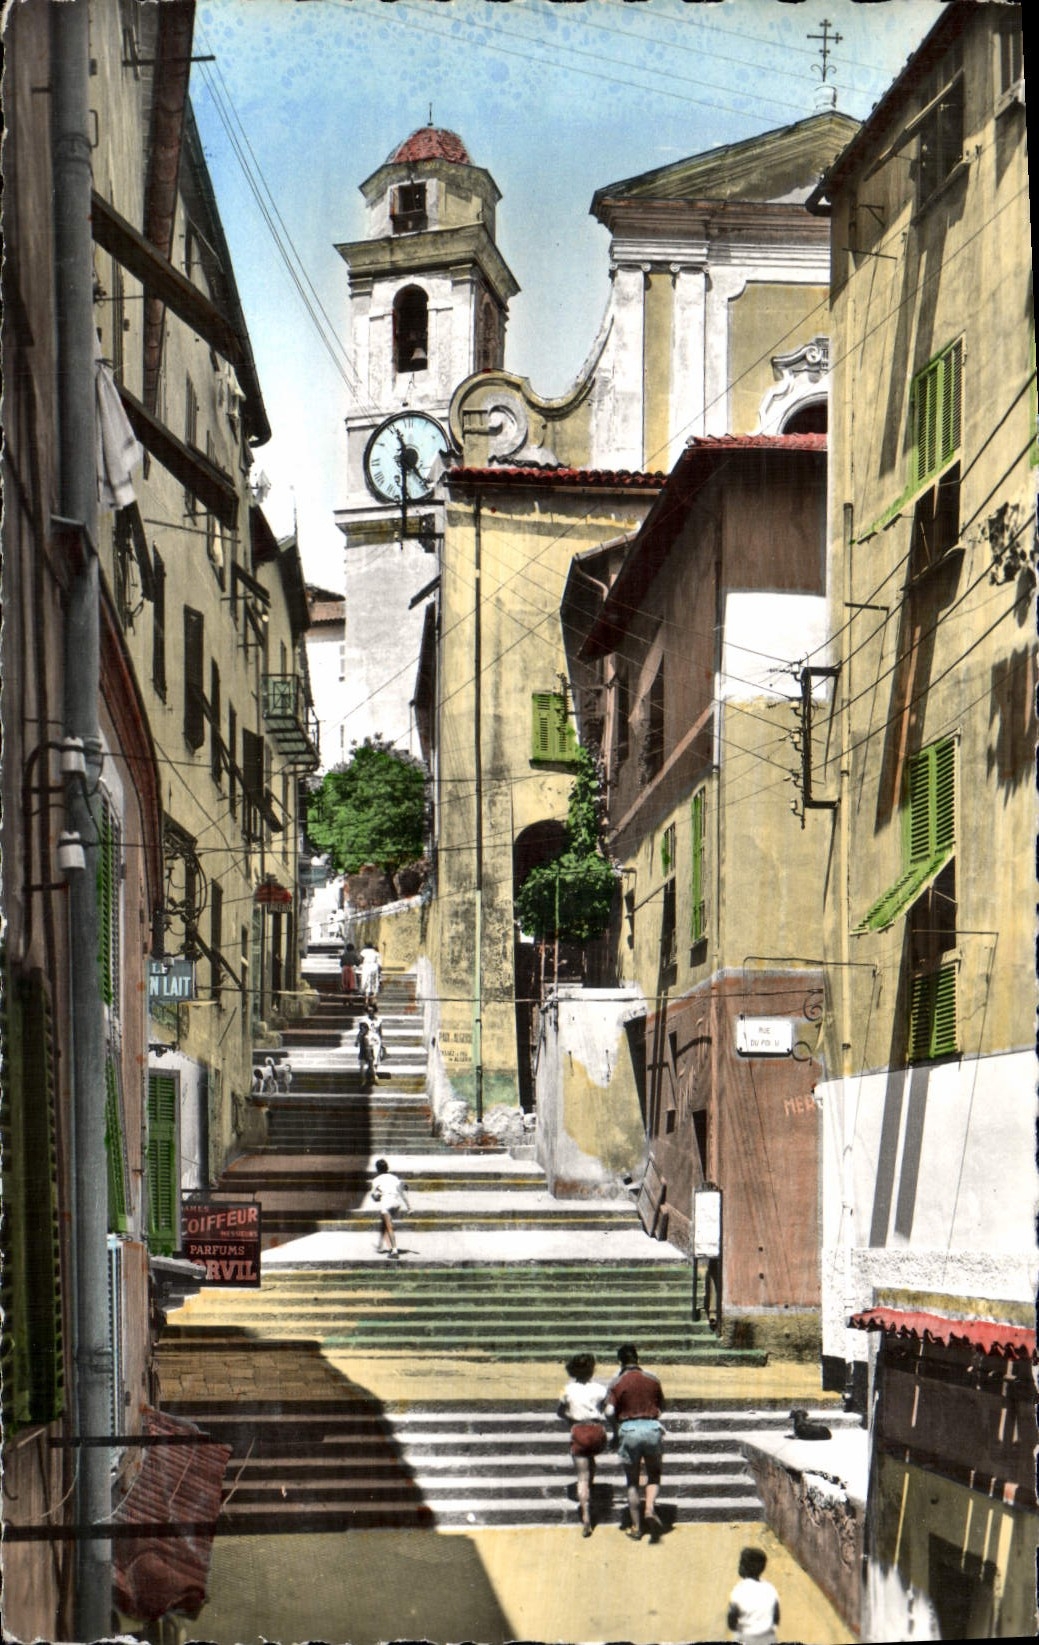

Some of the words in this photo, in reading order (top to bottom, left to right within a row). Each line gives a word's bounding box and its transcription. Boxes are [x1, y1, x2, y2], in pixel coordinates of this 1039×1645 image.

[163, 976, 191, 996] LAIT
[758, 1026, 771, 1035] RUE
[750, 1039, 760, 1047] DU
[182, 1205, 209, 1213] AMES
[190, 1245, 246, 1257] PARFUMS
